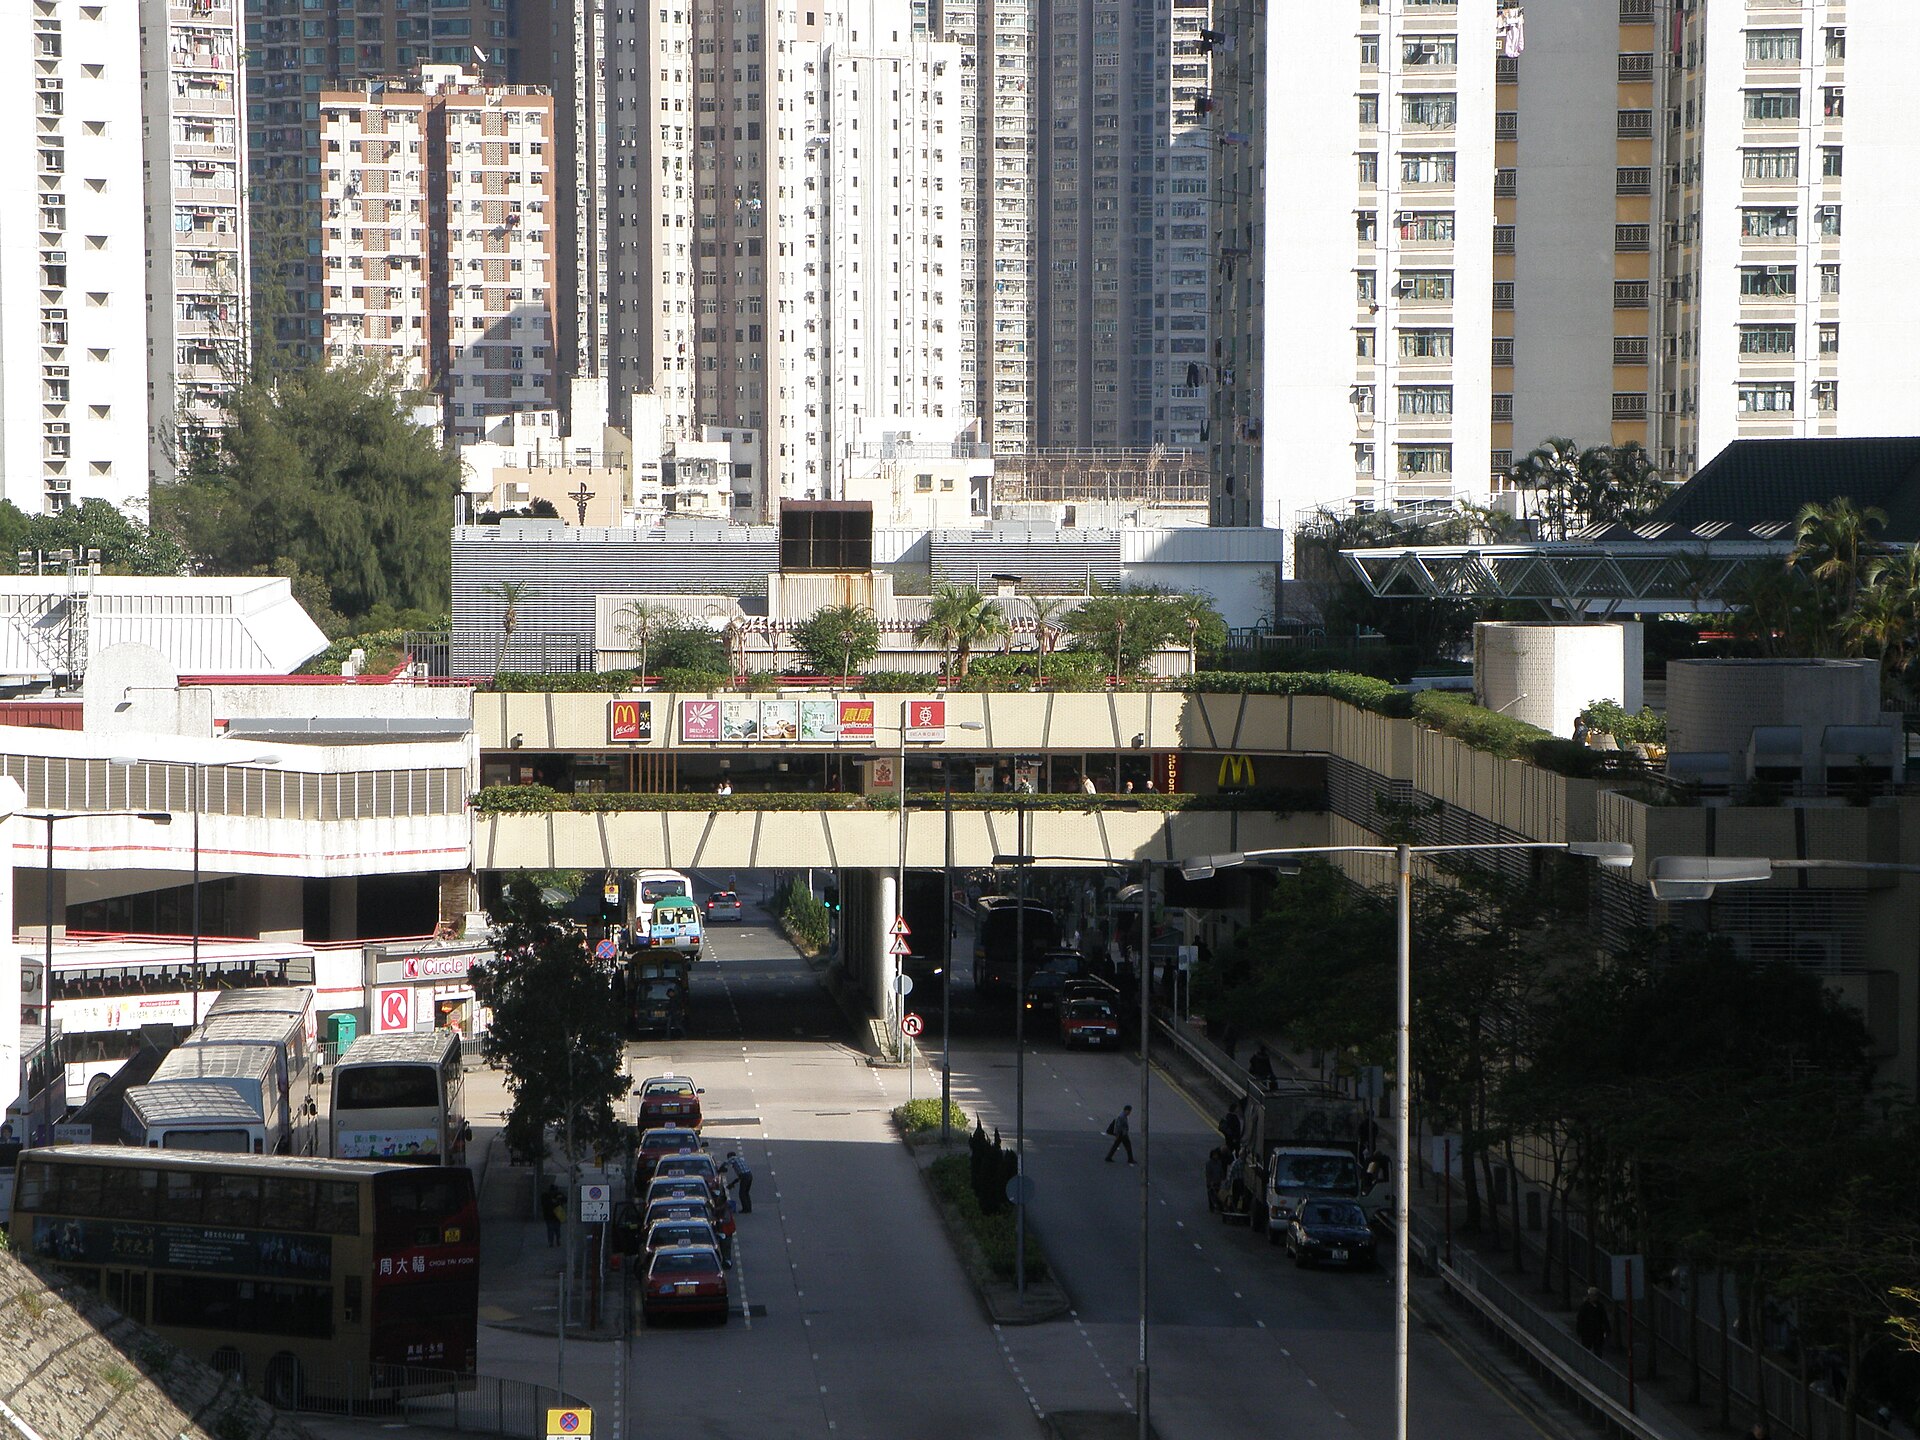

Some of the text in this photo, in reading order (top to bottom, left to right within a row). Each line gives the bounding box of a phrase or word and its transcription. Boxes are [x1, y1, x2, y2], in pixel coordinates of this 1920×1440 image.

[841, 707, 872, 722] 惠康
[639, 721, 651, 731] 24
[423, 957, 464, 975] Circle
[387, 996, 406, 1024] K
[599, 1213, 609, 1221] 12
[378, 1255, 475, 1276] 周大福 CHOW TAI FOOK
